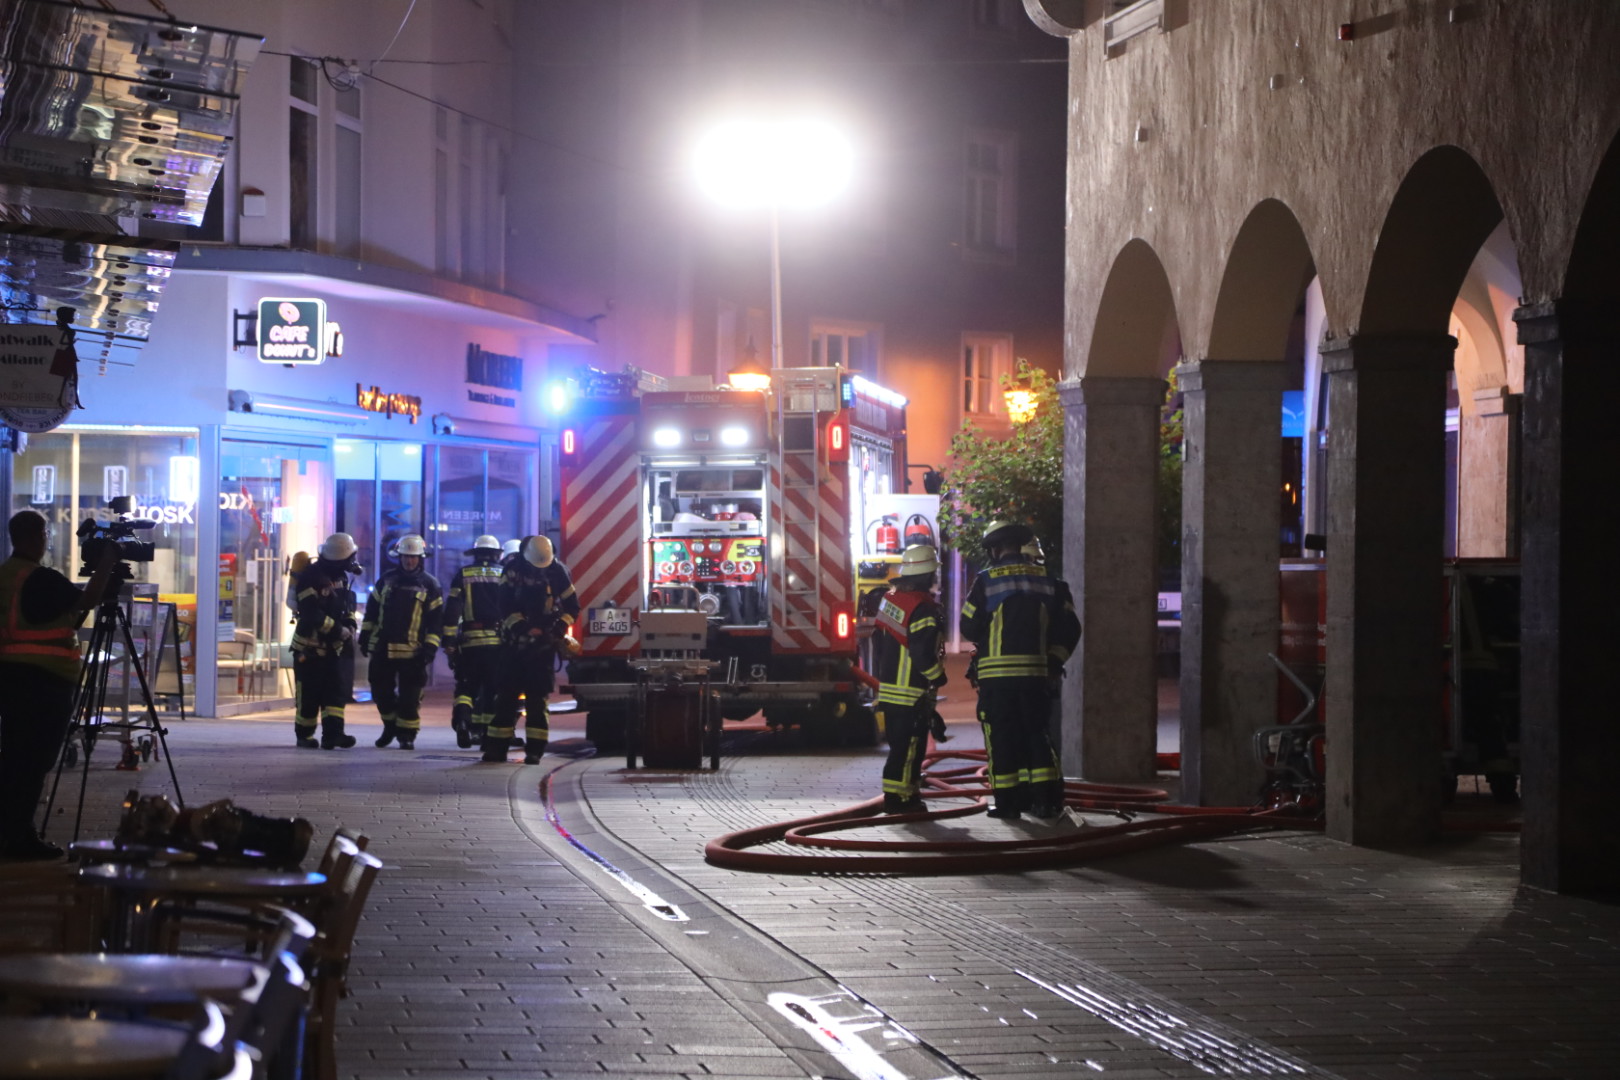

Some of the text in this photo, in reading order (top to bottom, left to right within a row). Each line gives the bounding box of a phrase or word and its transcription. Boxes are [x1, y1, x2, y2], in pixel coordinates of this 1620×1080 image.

[607, 610, 614, 621] A
[592, 621, 628, 632] BF 405
